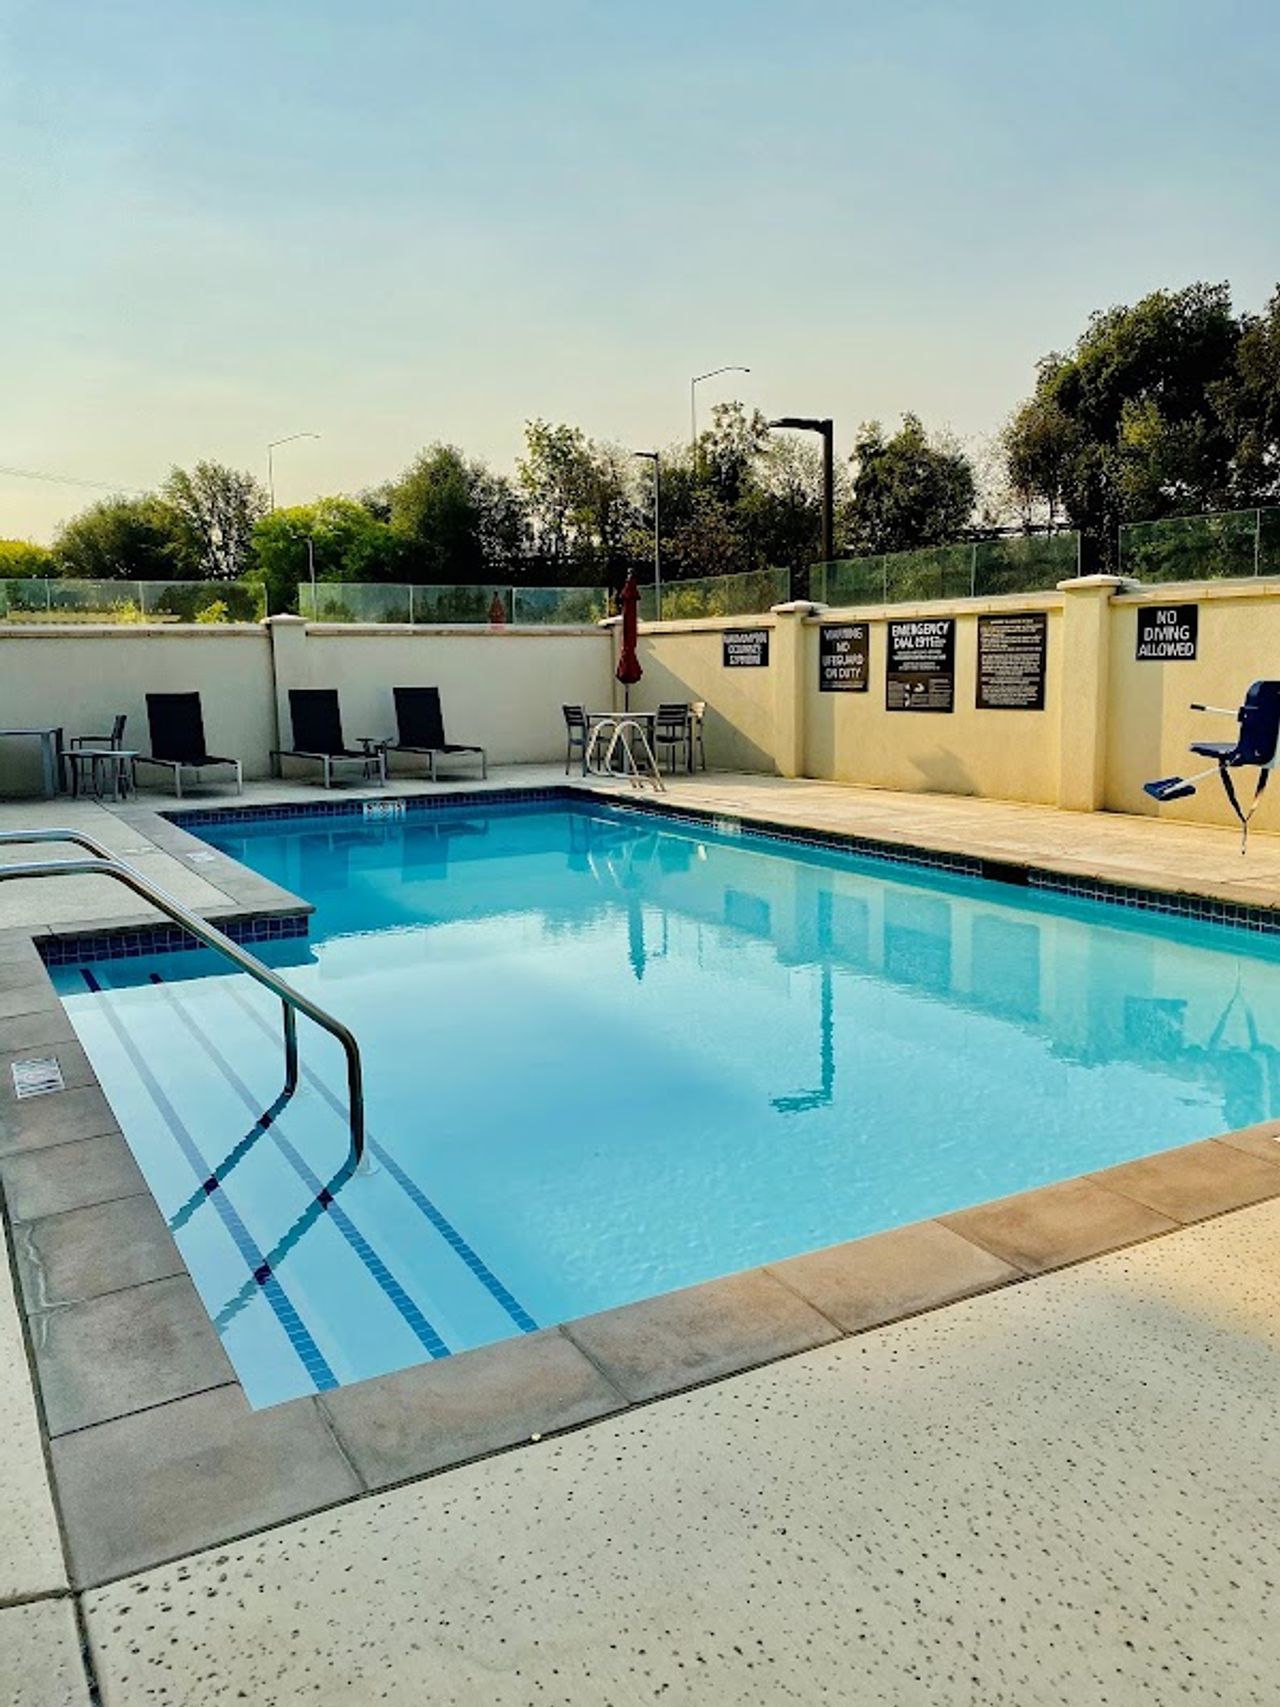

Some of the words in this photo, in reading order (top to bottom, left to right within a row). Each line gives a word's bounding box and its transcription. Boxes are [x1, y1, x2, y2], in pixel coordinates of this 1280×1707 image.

[1156, 610, 1177, 624] NO
[891, 621, 950, 637] EMERGENCY
[1143, 625, 1190, 641] DIVING
[836, 641, 850, 652] NO
[893, 636, 914, 649] DIAL
[1137, 642, 1194, 656] ALLOWED
[825, 668, 838, 679] ON
[838, 667, 861, 679] DUTY
